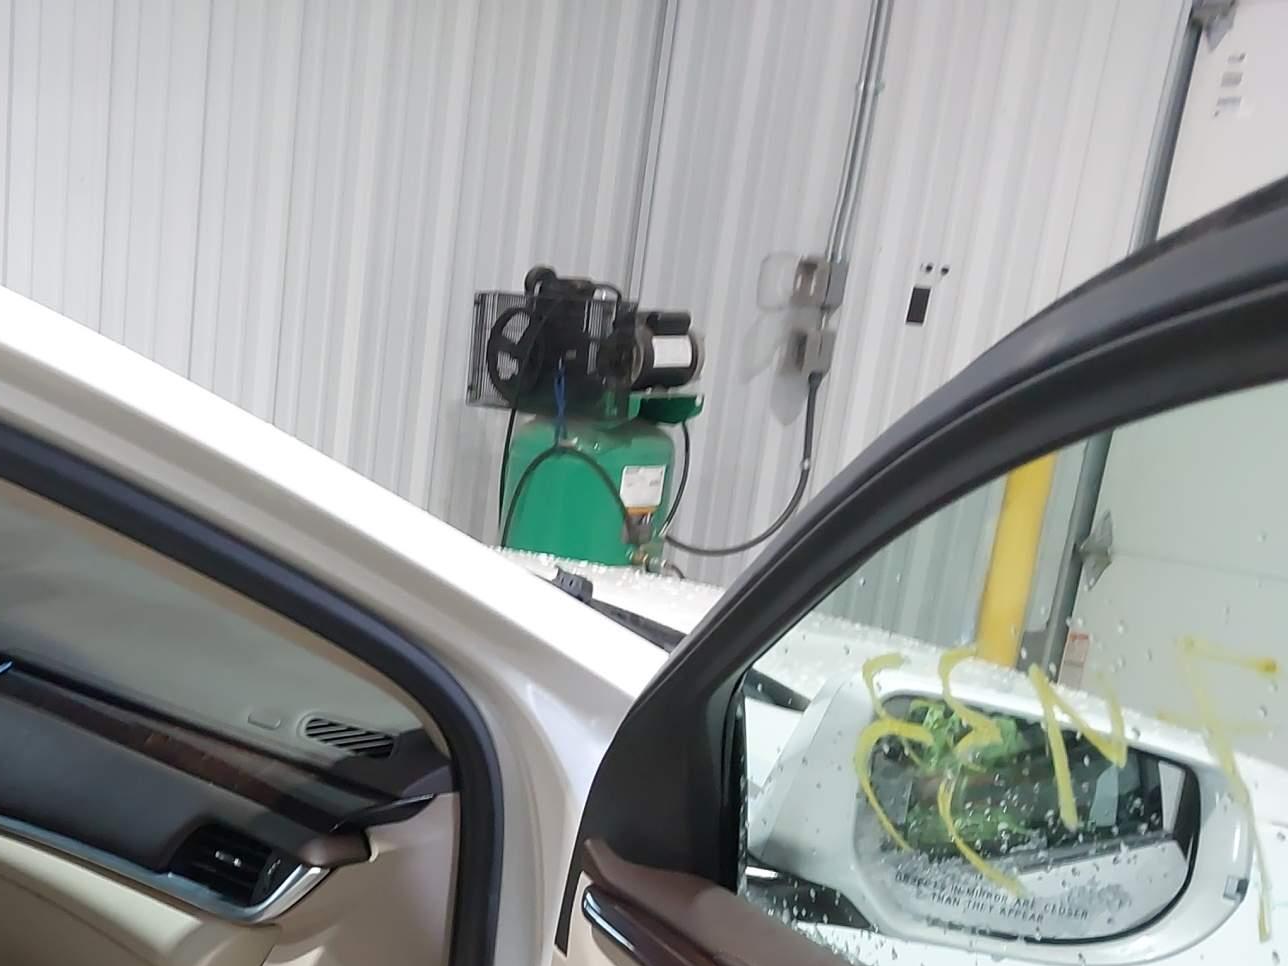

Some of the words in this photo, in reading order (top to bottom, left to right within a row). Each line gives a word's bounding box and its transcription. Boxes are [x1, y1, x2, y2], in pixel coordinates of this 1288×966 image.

[932, 891, 961, 908] THAN
[966, 900, 994, 915] THEY
[999, 905, 1045, 924] APPEAR
[1014, 897, 1036, 910] ARE
